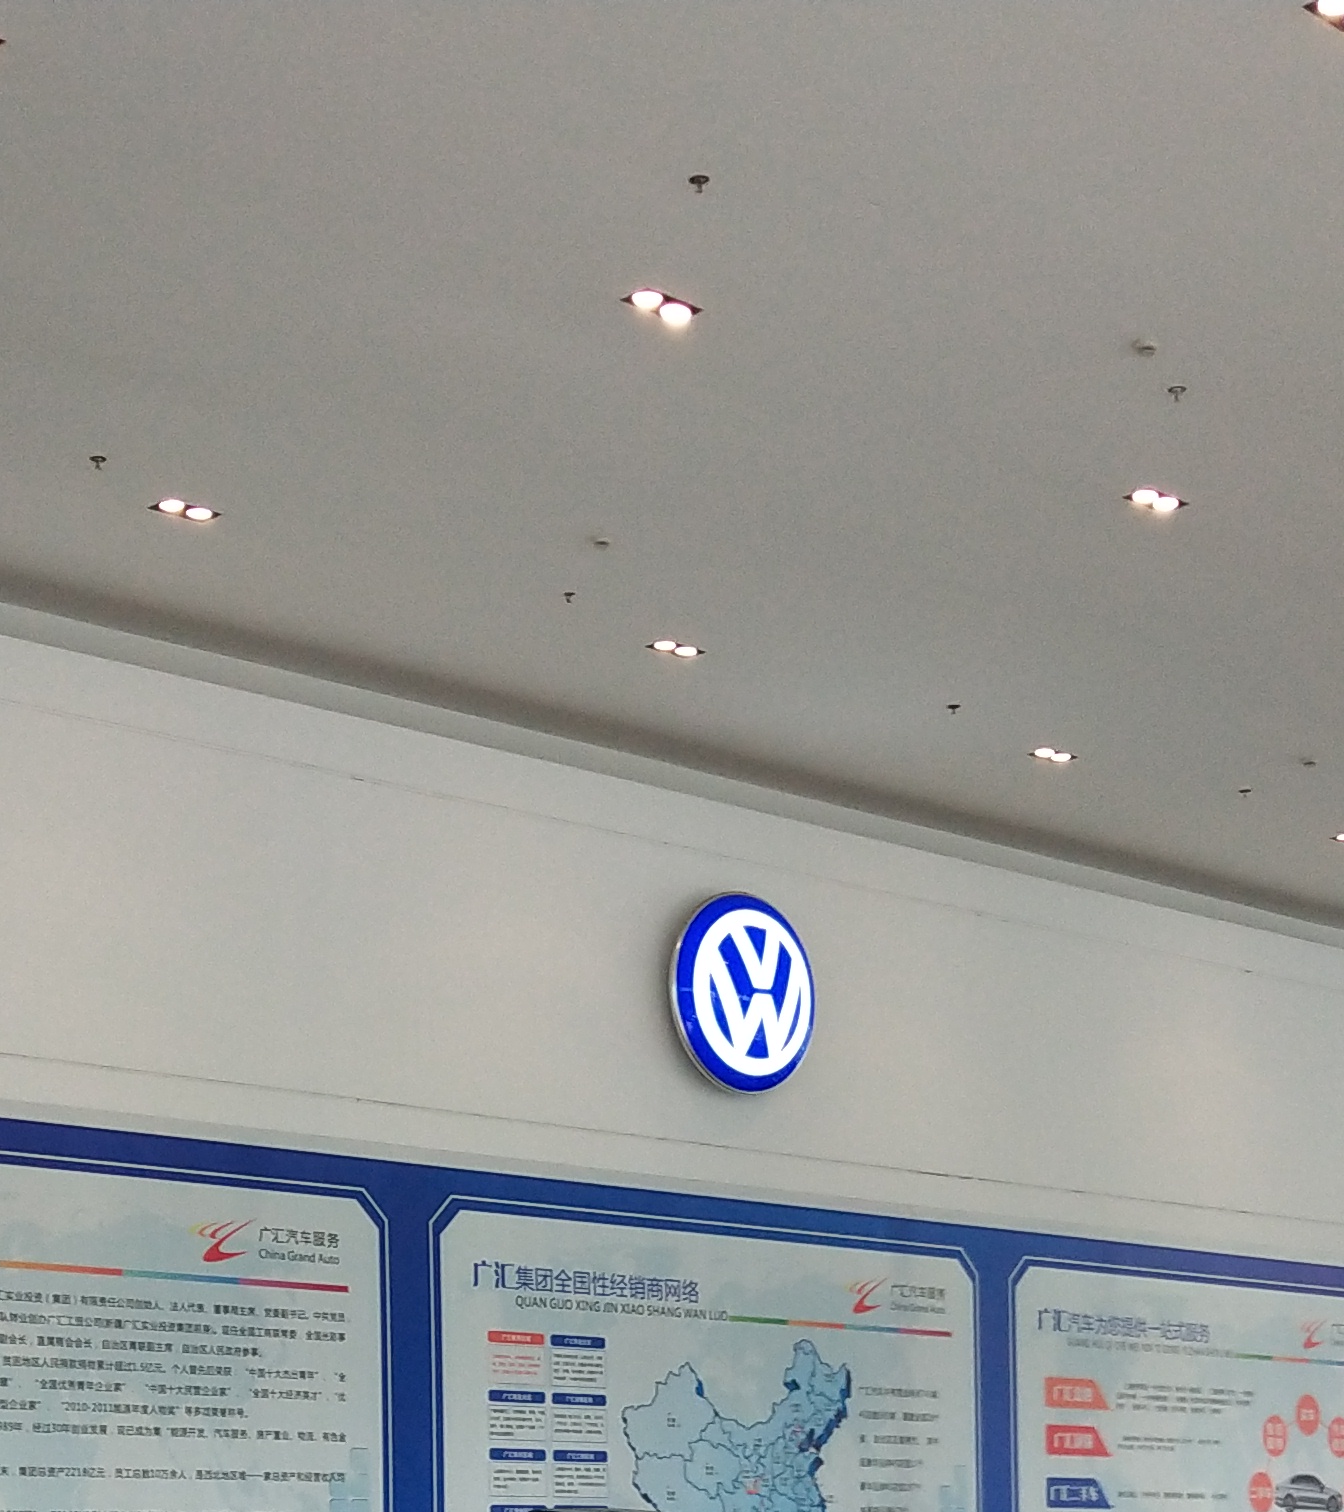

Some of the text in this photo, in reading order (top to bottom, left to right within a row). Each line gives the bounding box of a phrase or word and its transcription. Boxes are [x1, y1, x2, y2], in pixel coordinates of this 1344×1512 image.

[258, 1226, 340, 1249] 广汇汽车服务
[258, 1248, 340, 1266] China Grand Auto
[472, 1260, 700, 1304] 广汇集团全国性经销商网络
[516, 1295, 548, 1310] QUAN
[549, 1296, 574, 1310] GUO
